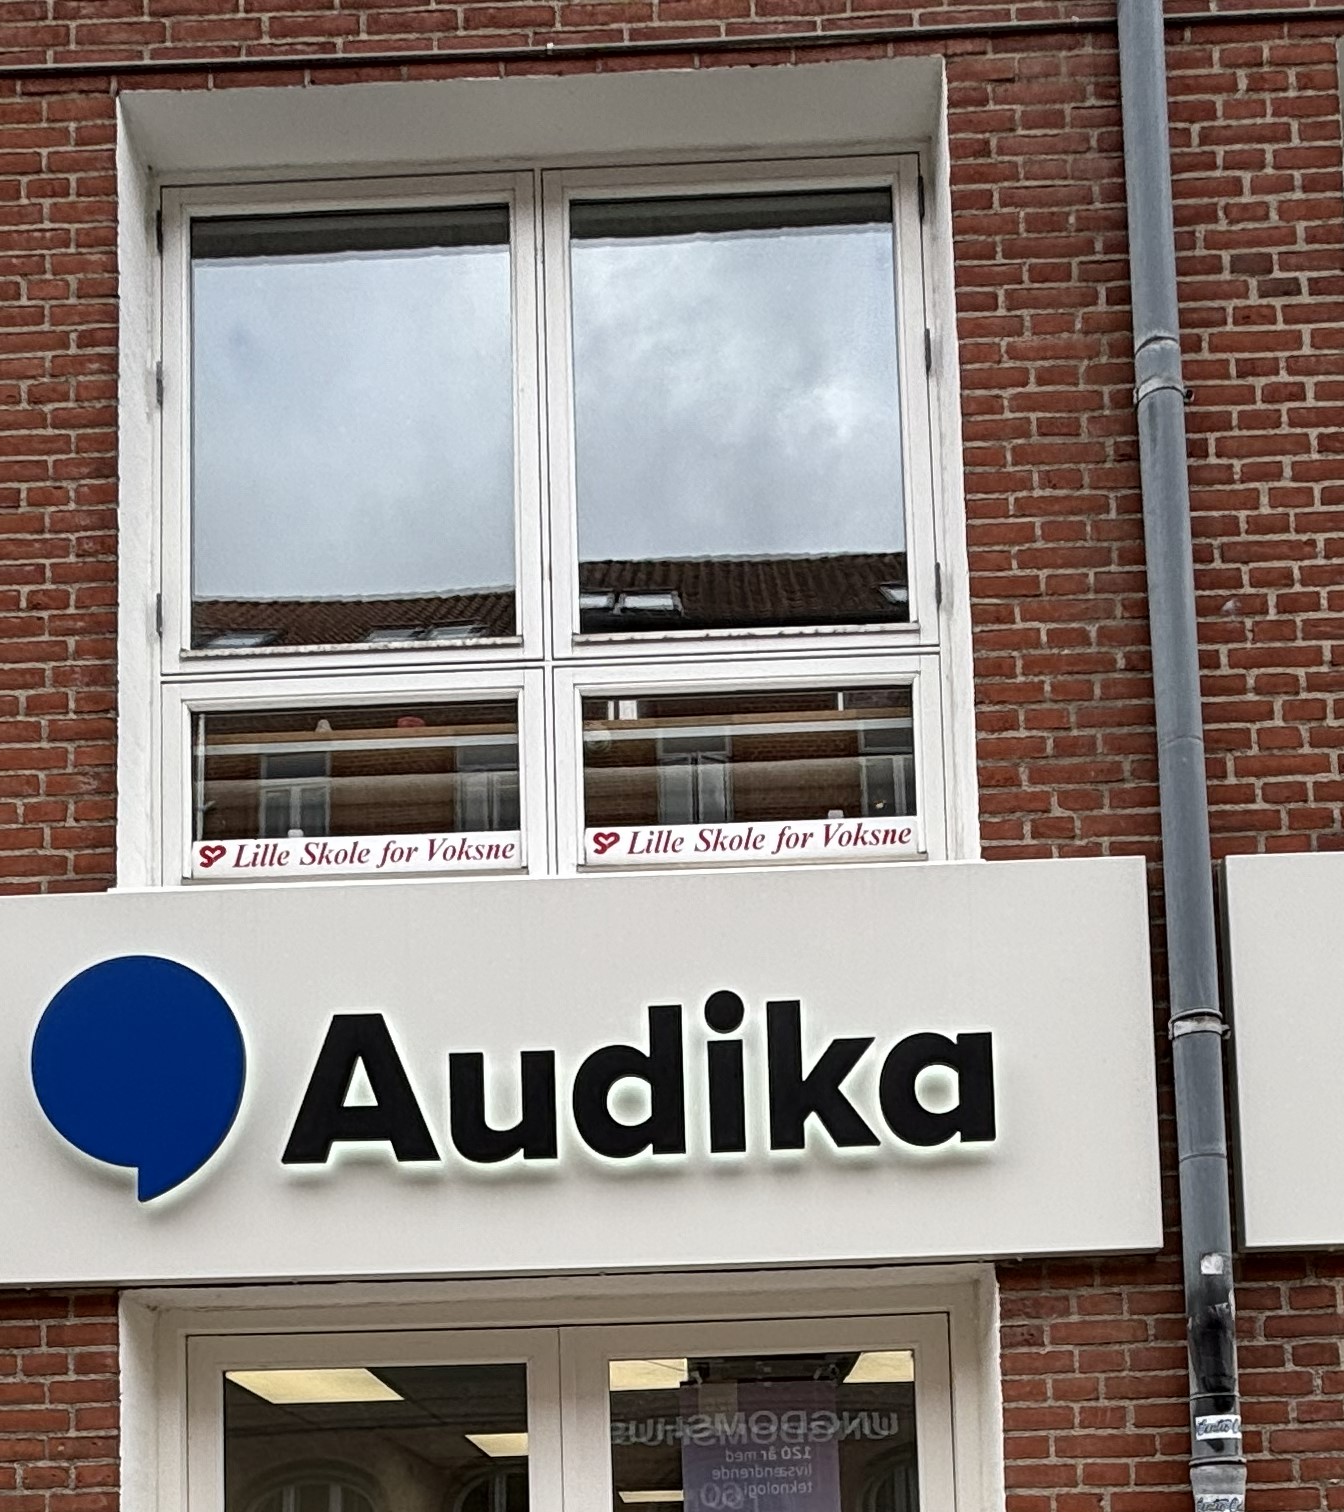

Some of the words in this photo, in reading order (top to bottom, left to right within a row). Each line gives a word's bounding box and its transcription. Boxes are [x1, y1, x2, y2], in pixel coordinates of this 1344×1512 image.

[232, 843, 291, 868] Lille
[299, 840, 371, 866] Skole
[376, 840, 418, 868] for
[427, 838, 516, 862] Voksne
[627, 830, 684, 855] Lille
[694, 826, 766, 852] Skole
[770, 826, 814, 854] for
[822, 822, 912, 848] Voksne
[281, 990, 997, 1165] Audika
